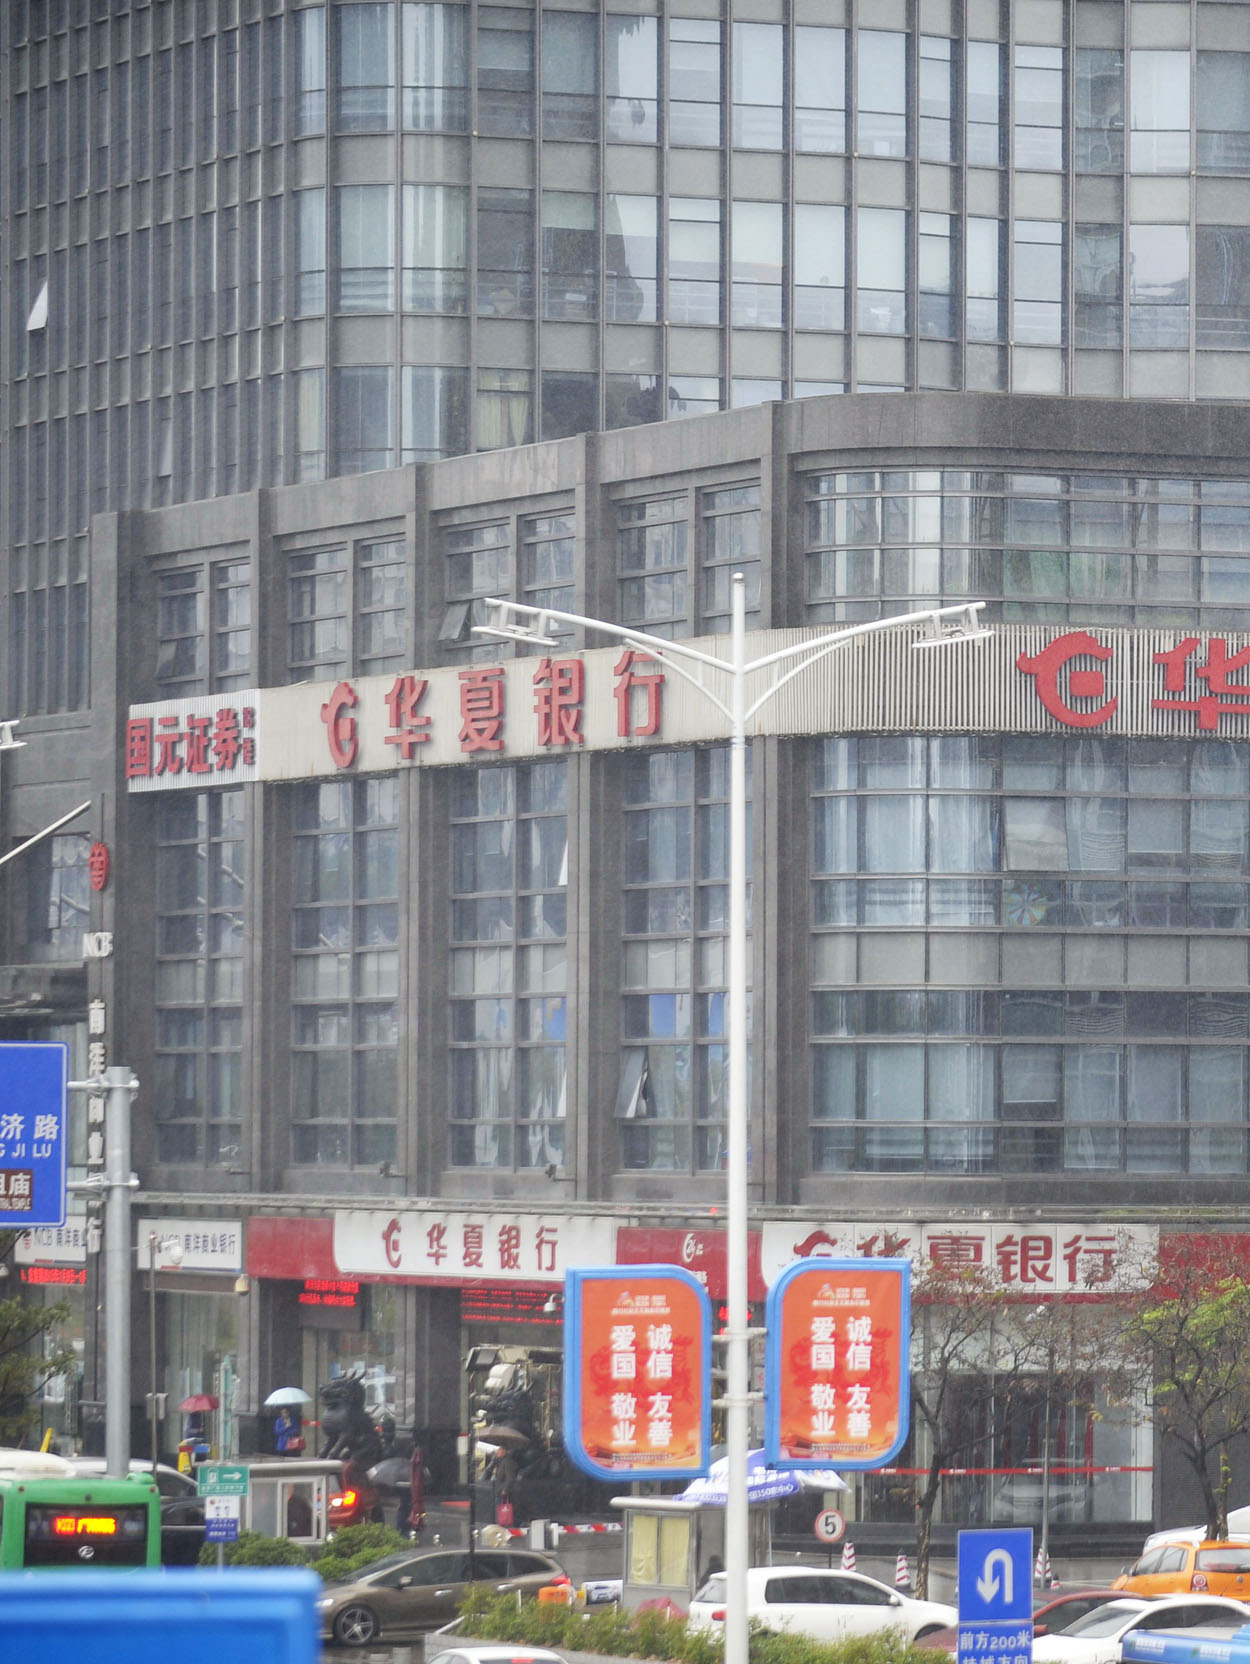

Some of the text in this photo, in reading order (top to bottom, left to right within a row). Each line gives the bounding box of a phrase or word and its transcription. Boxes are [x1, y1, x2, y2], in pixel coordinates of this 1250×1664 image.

[384, 650, 665, 760] 华夏银行
[126, 708, 241, 779] 国元证券
[426, 1222, 558, 1271] 华夏银行
[647, 1324, 673, 1379] 诚信
[846, 1316, 872, 1370] 诚信
[611, 1324, 636, 1446] 爱国 敬业
[811, 1316, 835, 1437] 爱国 敬业
[647, 1392, 673, 1446] 友善
[846, 1384, 872, 1437] 友善
[824, 1514, 836, 1535] 5
[960, 1630, 1031, 1651] 前方200米
